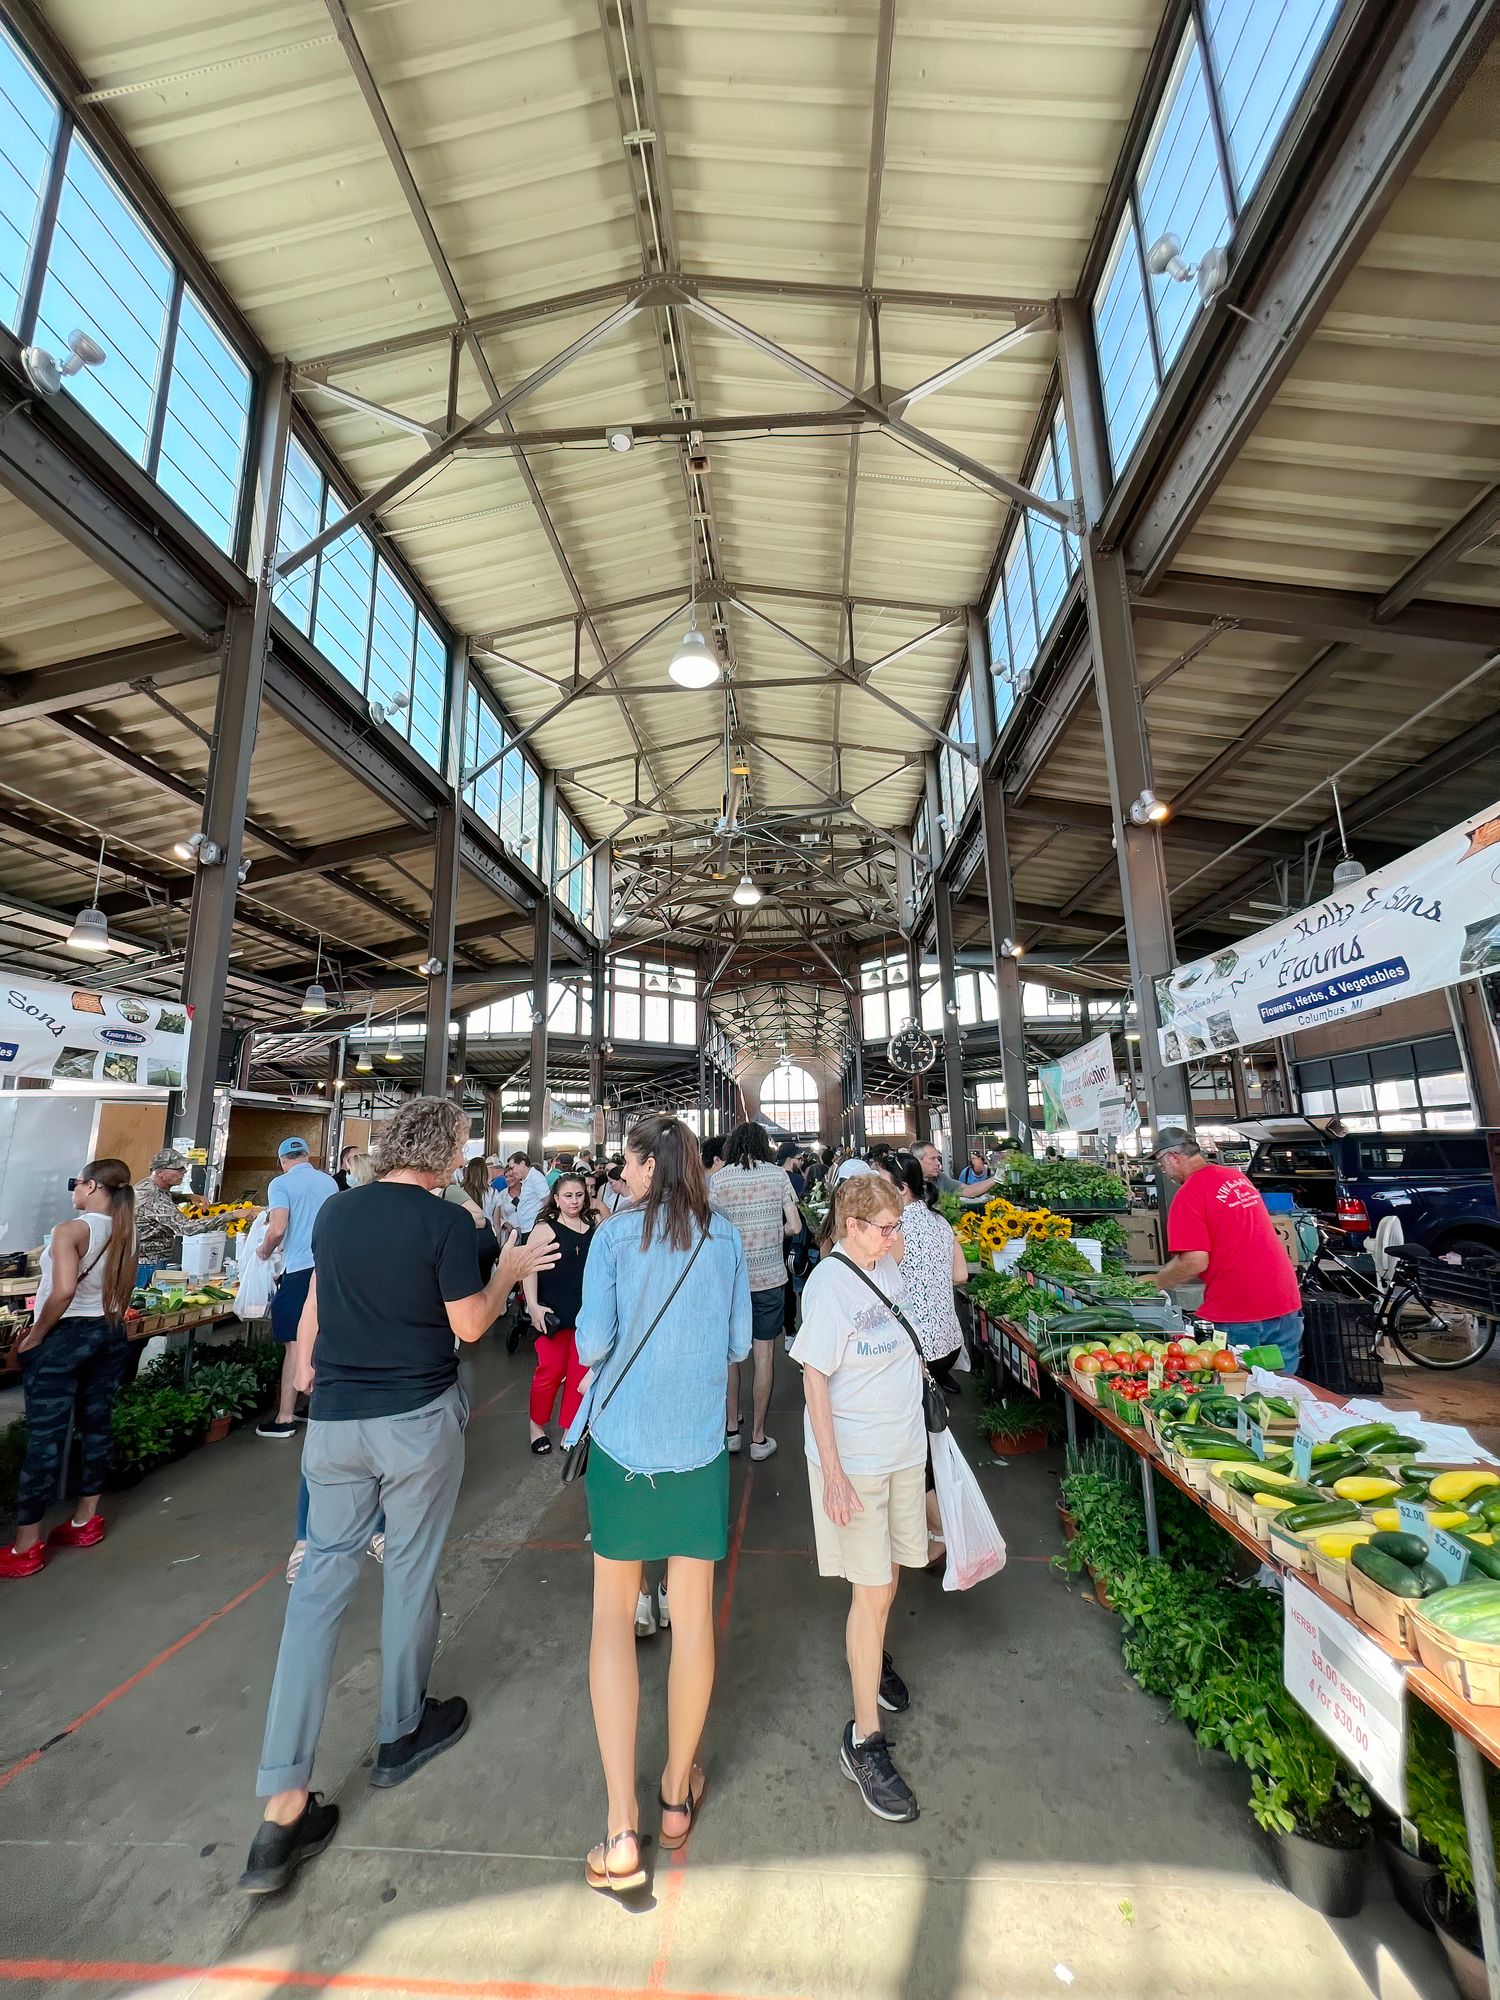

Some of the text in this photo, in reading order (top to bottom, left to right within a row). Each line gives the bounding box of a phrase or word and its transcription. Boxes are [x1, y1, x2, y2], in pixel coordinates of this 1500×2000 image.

[1382, 886, 1443, 923] Sons
[1278, 935, 1365, 989] Farms
[1260, 965, 1405, 1018] Flowers, Herbs, & Vegetables
[8, 990, 67, 1038] Sons
[1297, 999, 1364, 1027] Columbus, MI
[1399, 1504, 1425, 1522] $2.00
[1434, 1531, 1462, 1562] $2.00
[1290, 1605, 1318, 1640] HERBS
[1311, 1650, 1367, 1717] $8.00 each
[1309, 1677, 1370, 1752] 4 for $30.00
